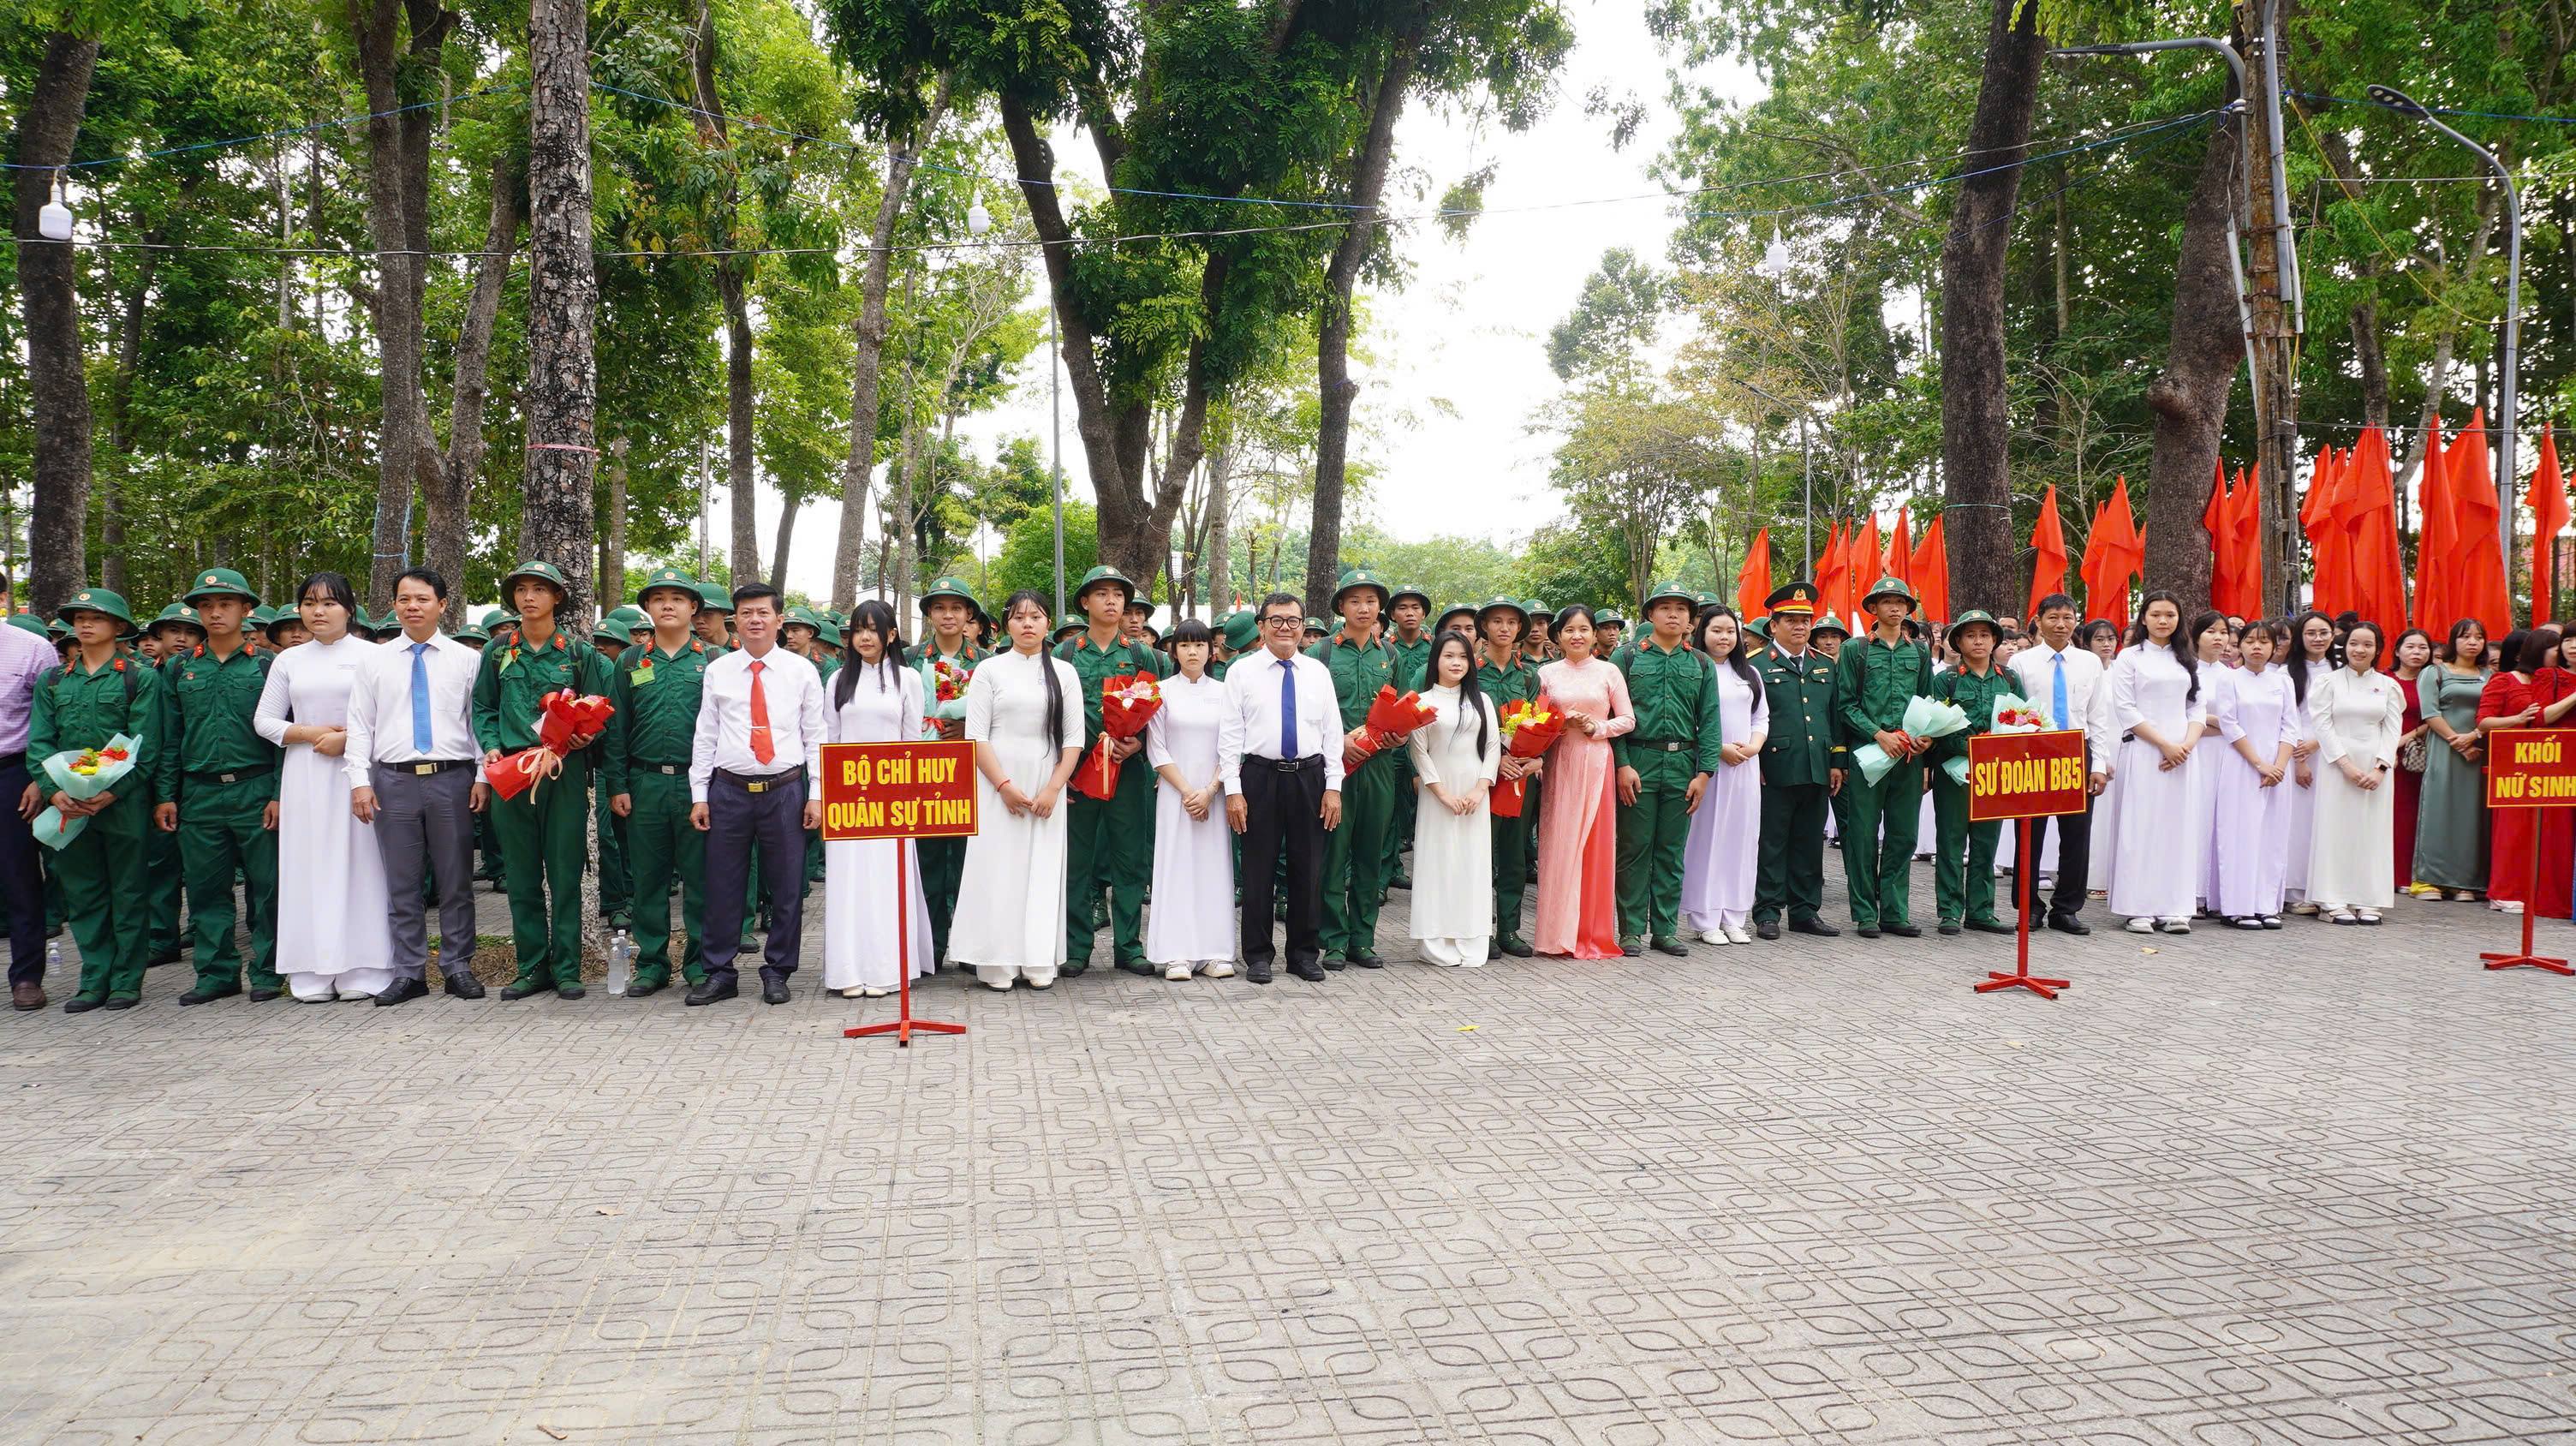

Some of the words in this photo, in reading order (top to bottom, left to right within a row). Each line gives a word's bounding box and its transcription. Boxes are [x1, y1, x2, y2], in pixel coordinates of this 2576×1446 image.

[2514, 734, 2562, 763] KHỐI
[843, 754, 871, 791] BỘ
[876, 750, 911, 786] CHỈ
[917, 757, 957, 784] HUY
[1975, 757, 2000, 797] SƯ
[2001, 752, 2046, 795] ĐOÀN
[2049, 757, 2082, 792] BB5
[2496, 772, 2527, 798] NỮ
[2528, 775, 2576, 798] SINH
[827, 796, 885, 832] QUÂN
[890, 797, 921, 831] SỰ
[922, 792, 971, 826] TỈNH
